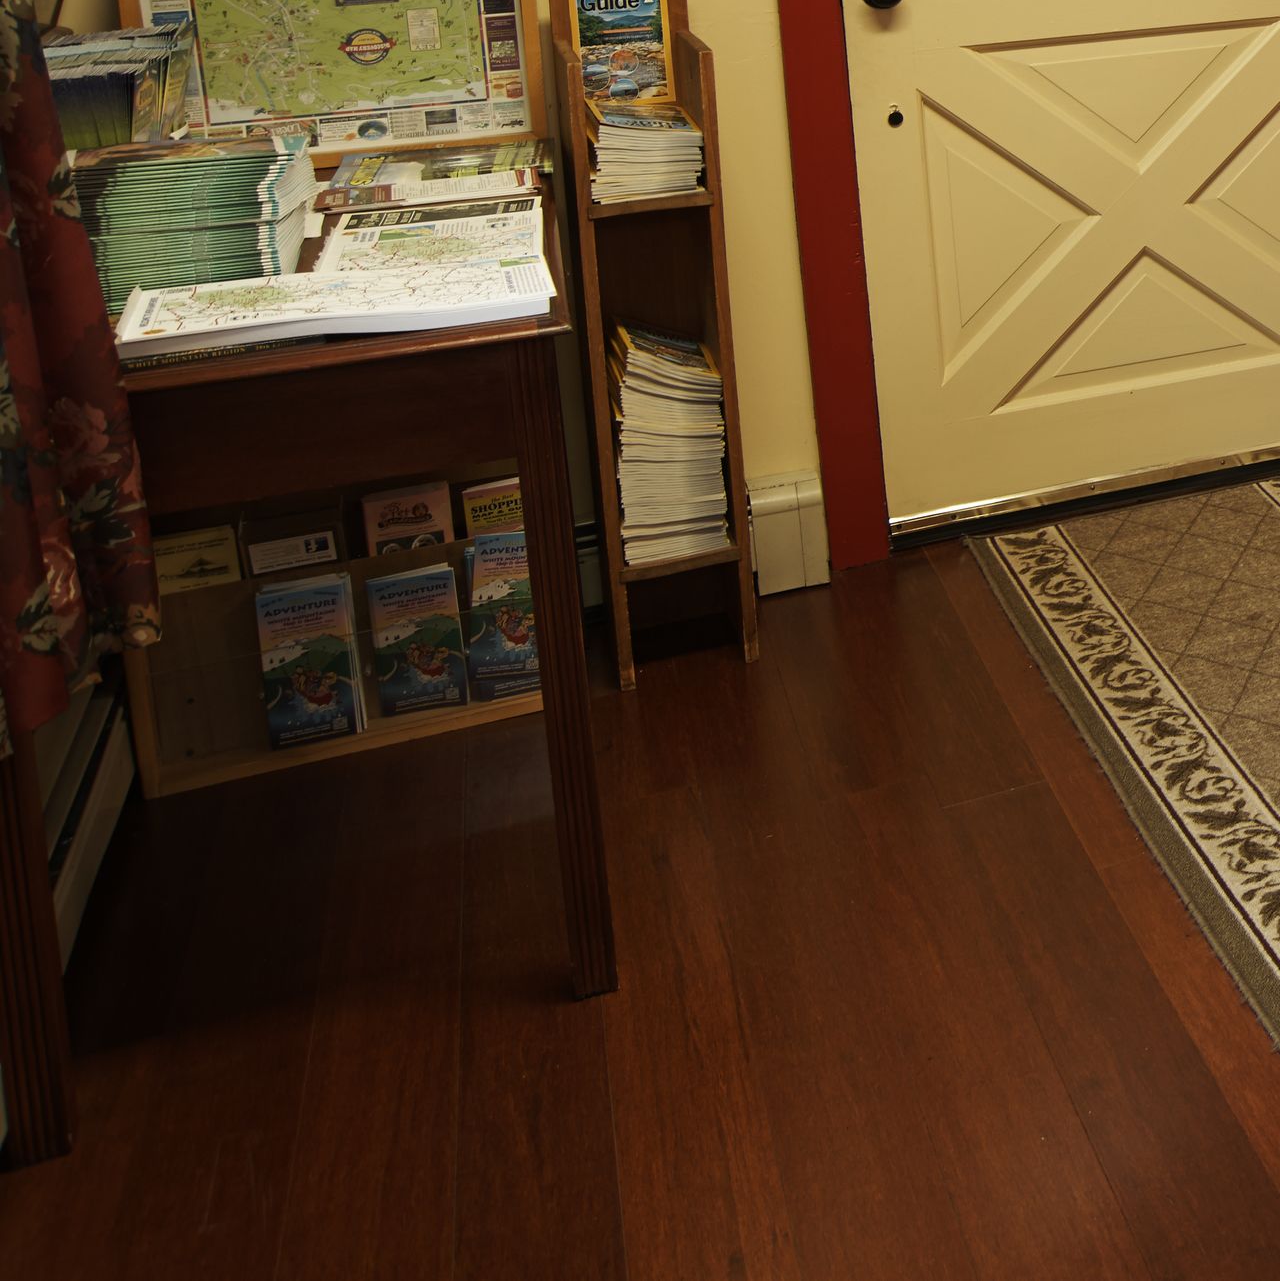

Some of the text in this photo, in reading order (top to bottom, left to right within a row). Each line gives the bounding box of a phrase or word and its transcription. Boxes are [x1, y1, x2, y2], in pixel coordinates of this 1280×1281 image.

[127, 346, 247, 369] WHITE MOUNTAIN REGION
[379, 582, 449, 601] ADVENTURE
[263, 598, 337, 618] ADVENTURE
